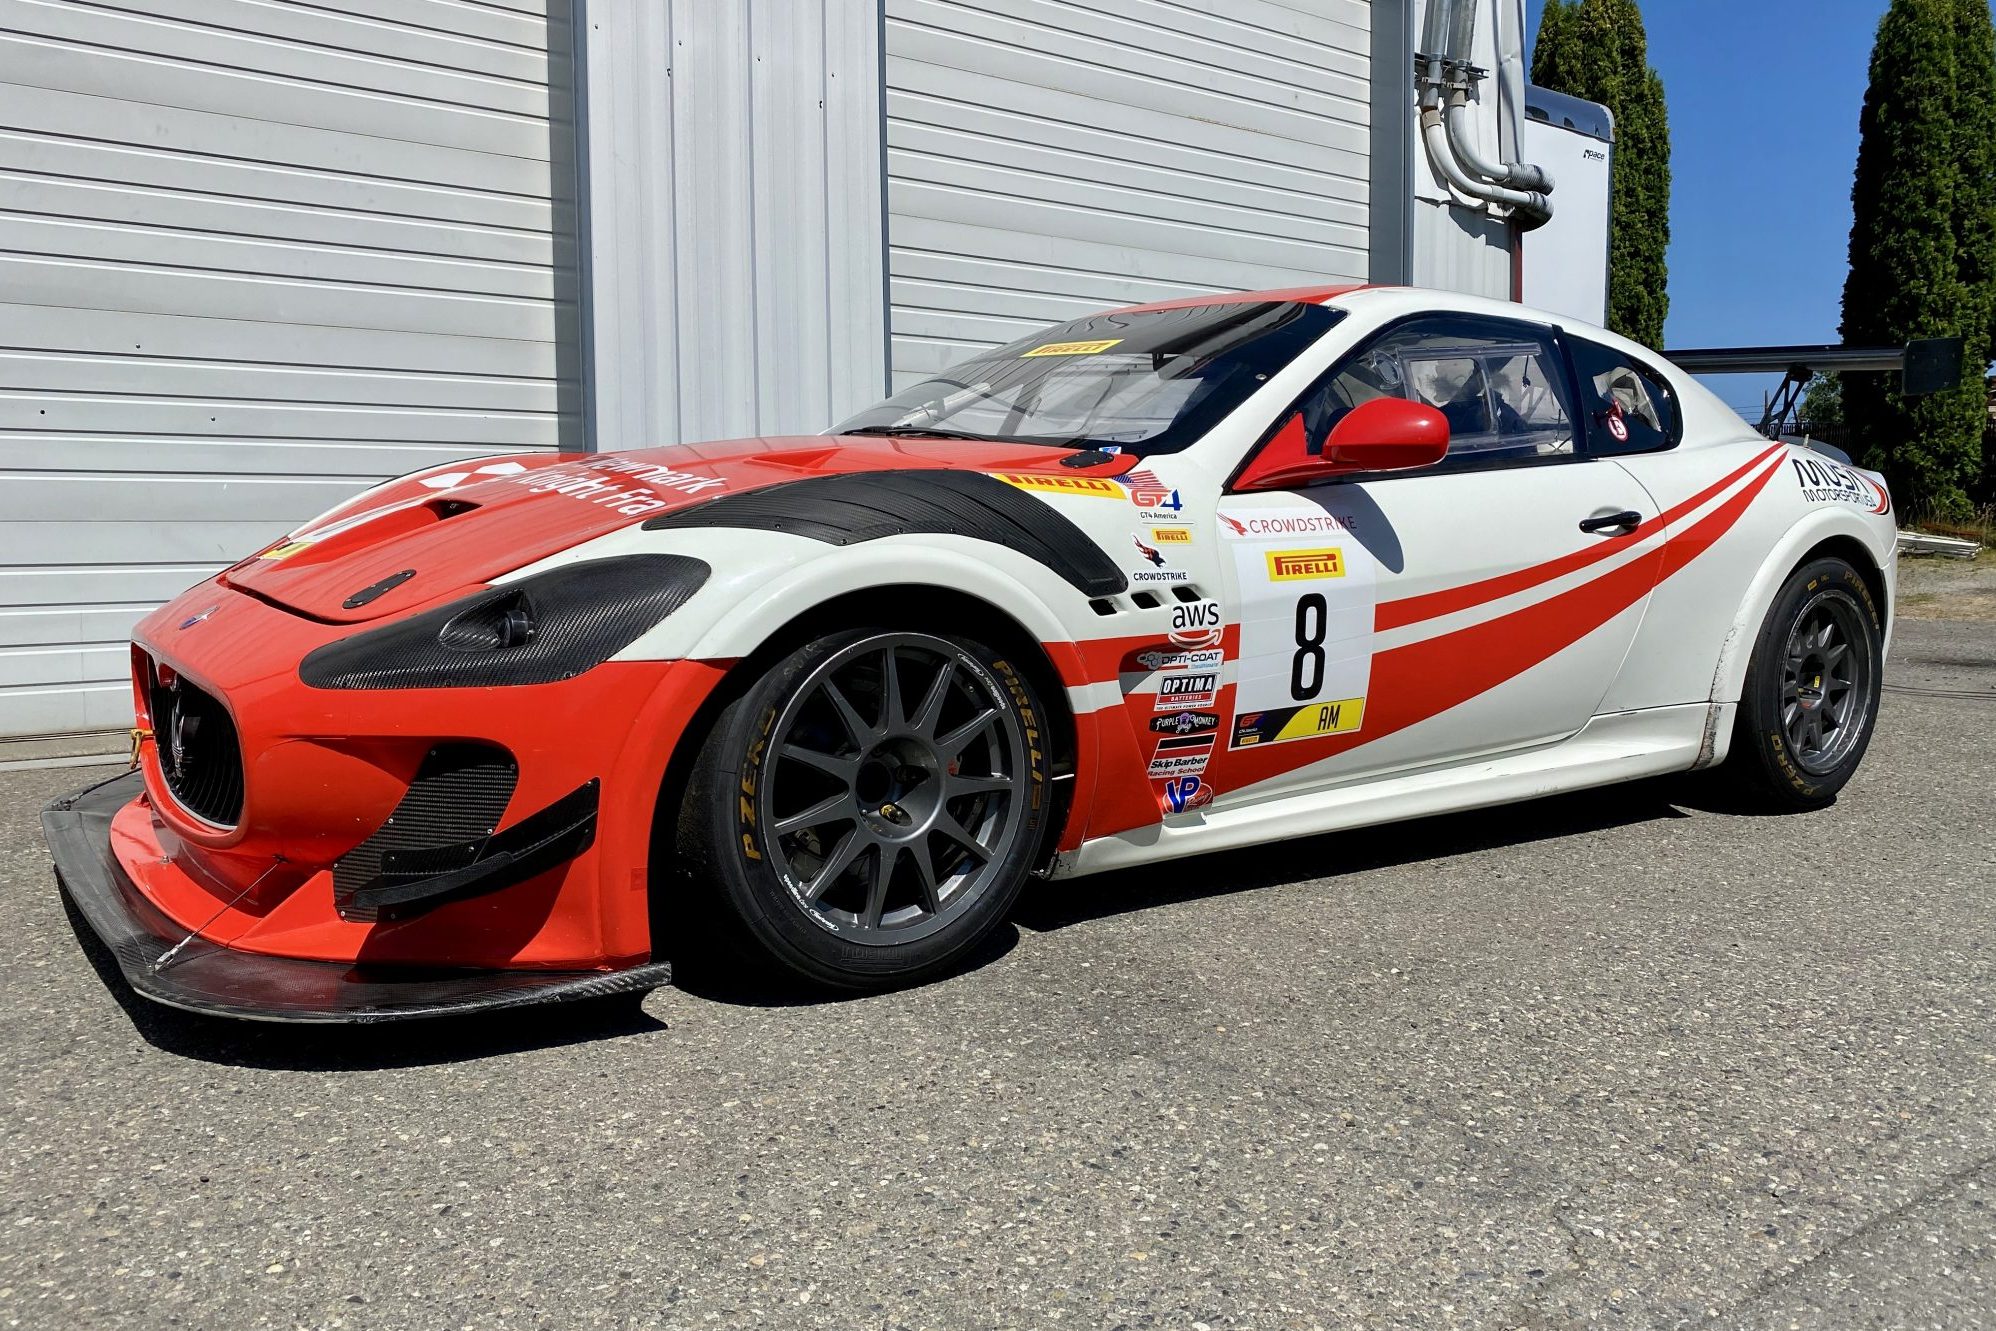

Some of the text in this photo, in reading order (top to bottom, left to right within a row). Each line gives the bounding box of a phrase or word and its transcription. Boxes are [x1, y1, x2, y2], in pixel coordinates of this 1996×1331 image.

[1004, 473, 1112, 492] PIRELLI
[1791, 458, 1870, 491] MUSA
[1153, 512, 1178, 520] America
[1249, 516, 1358, 534] CROWDSTRIKE
[1155, 530, 1189, 541] PIRELLI
[1273, 553, 1338, 576] PIRELLI
[1133, 572, 1188, 581] CROWDSTRIKE
[1172, 603, 1220, 629] aws
[1290, 592, 1328, 702] 8
[1161, 652, 1222, 665] OPTI-COAT
[1163, 677, 1214, 694] OPTIMA
[1170, 694, 1203, 702] BATTERIES
[992, 659, 1043, 783] PIRELLI
[1156, 716, 1216, 731] PURPLE MONKEY
[1317, 704, 1341, 731] AM
[1151, 757, 1209, 770] Skip Barber
[1177, 766, 1205, 775] School
[1166, 776, 1201, 814] VP
